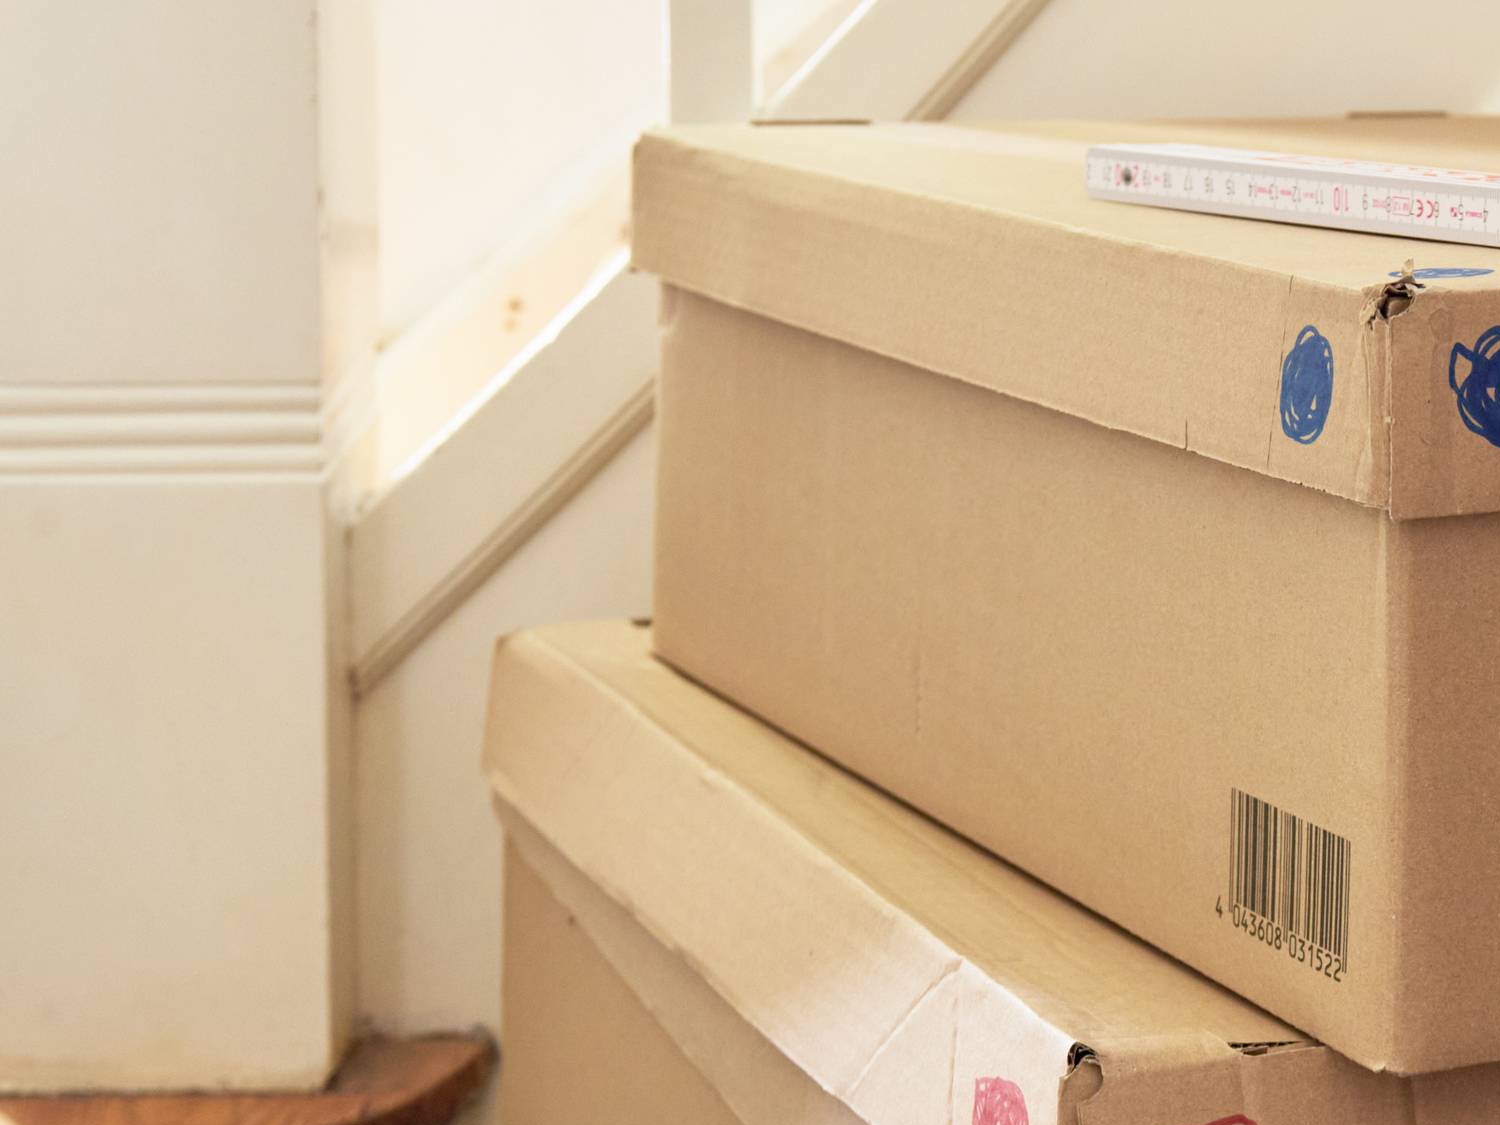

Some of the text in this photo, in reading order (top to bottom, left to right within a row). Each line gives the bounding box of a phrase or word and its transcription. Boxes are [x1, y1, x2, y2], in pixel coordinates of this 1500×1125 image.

[1333, 187, 1349, 212] 10
[1215, 896, 1342, 983] 4 043608 031522
